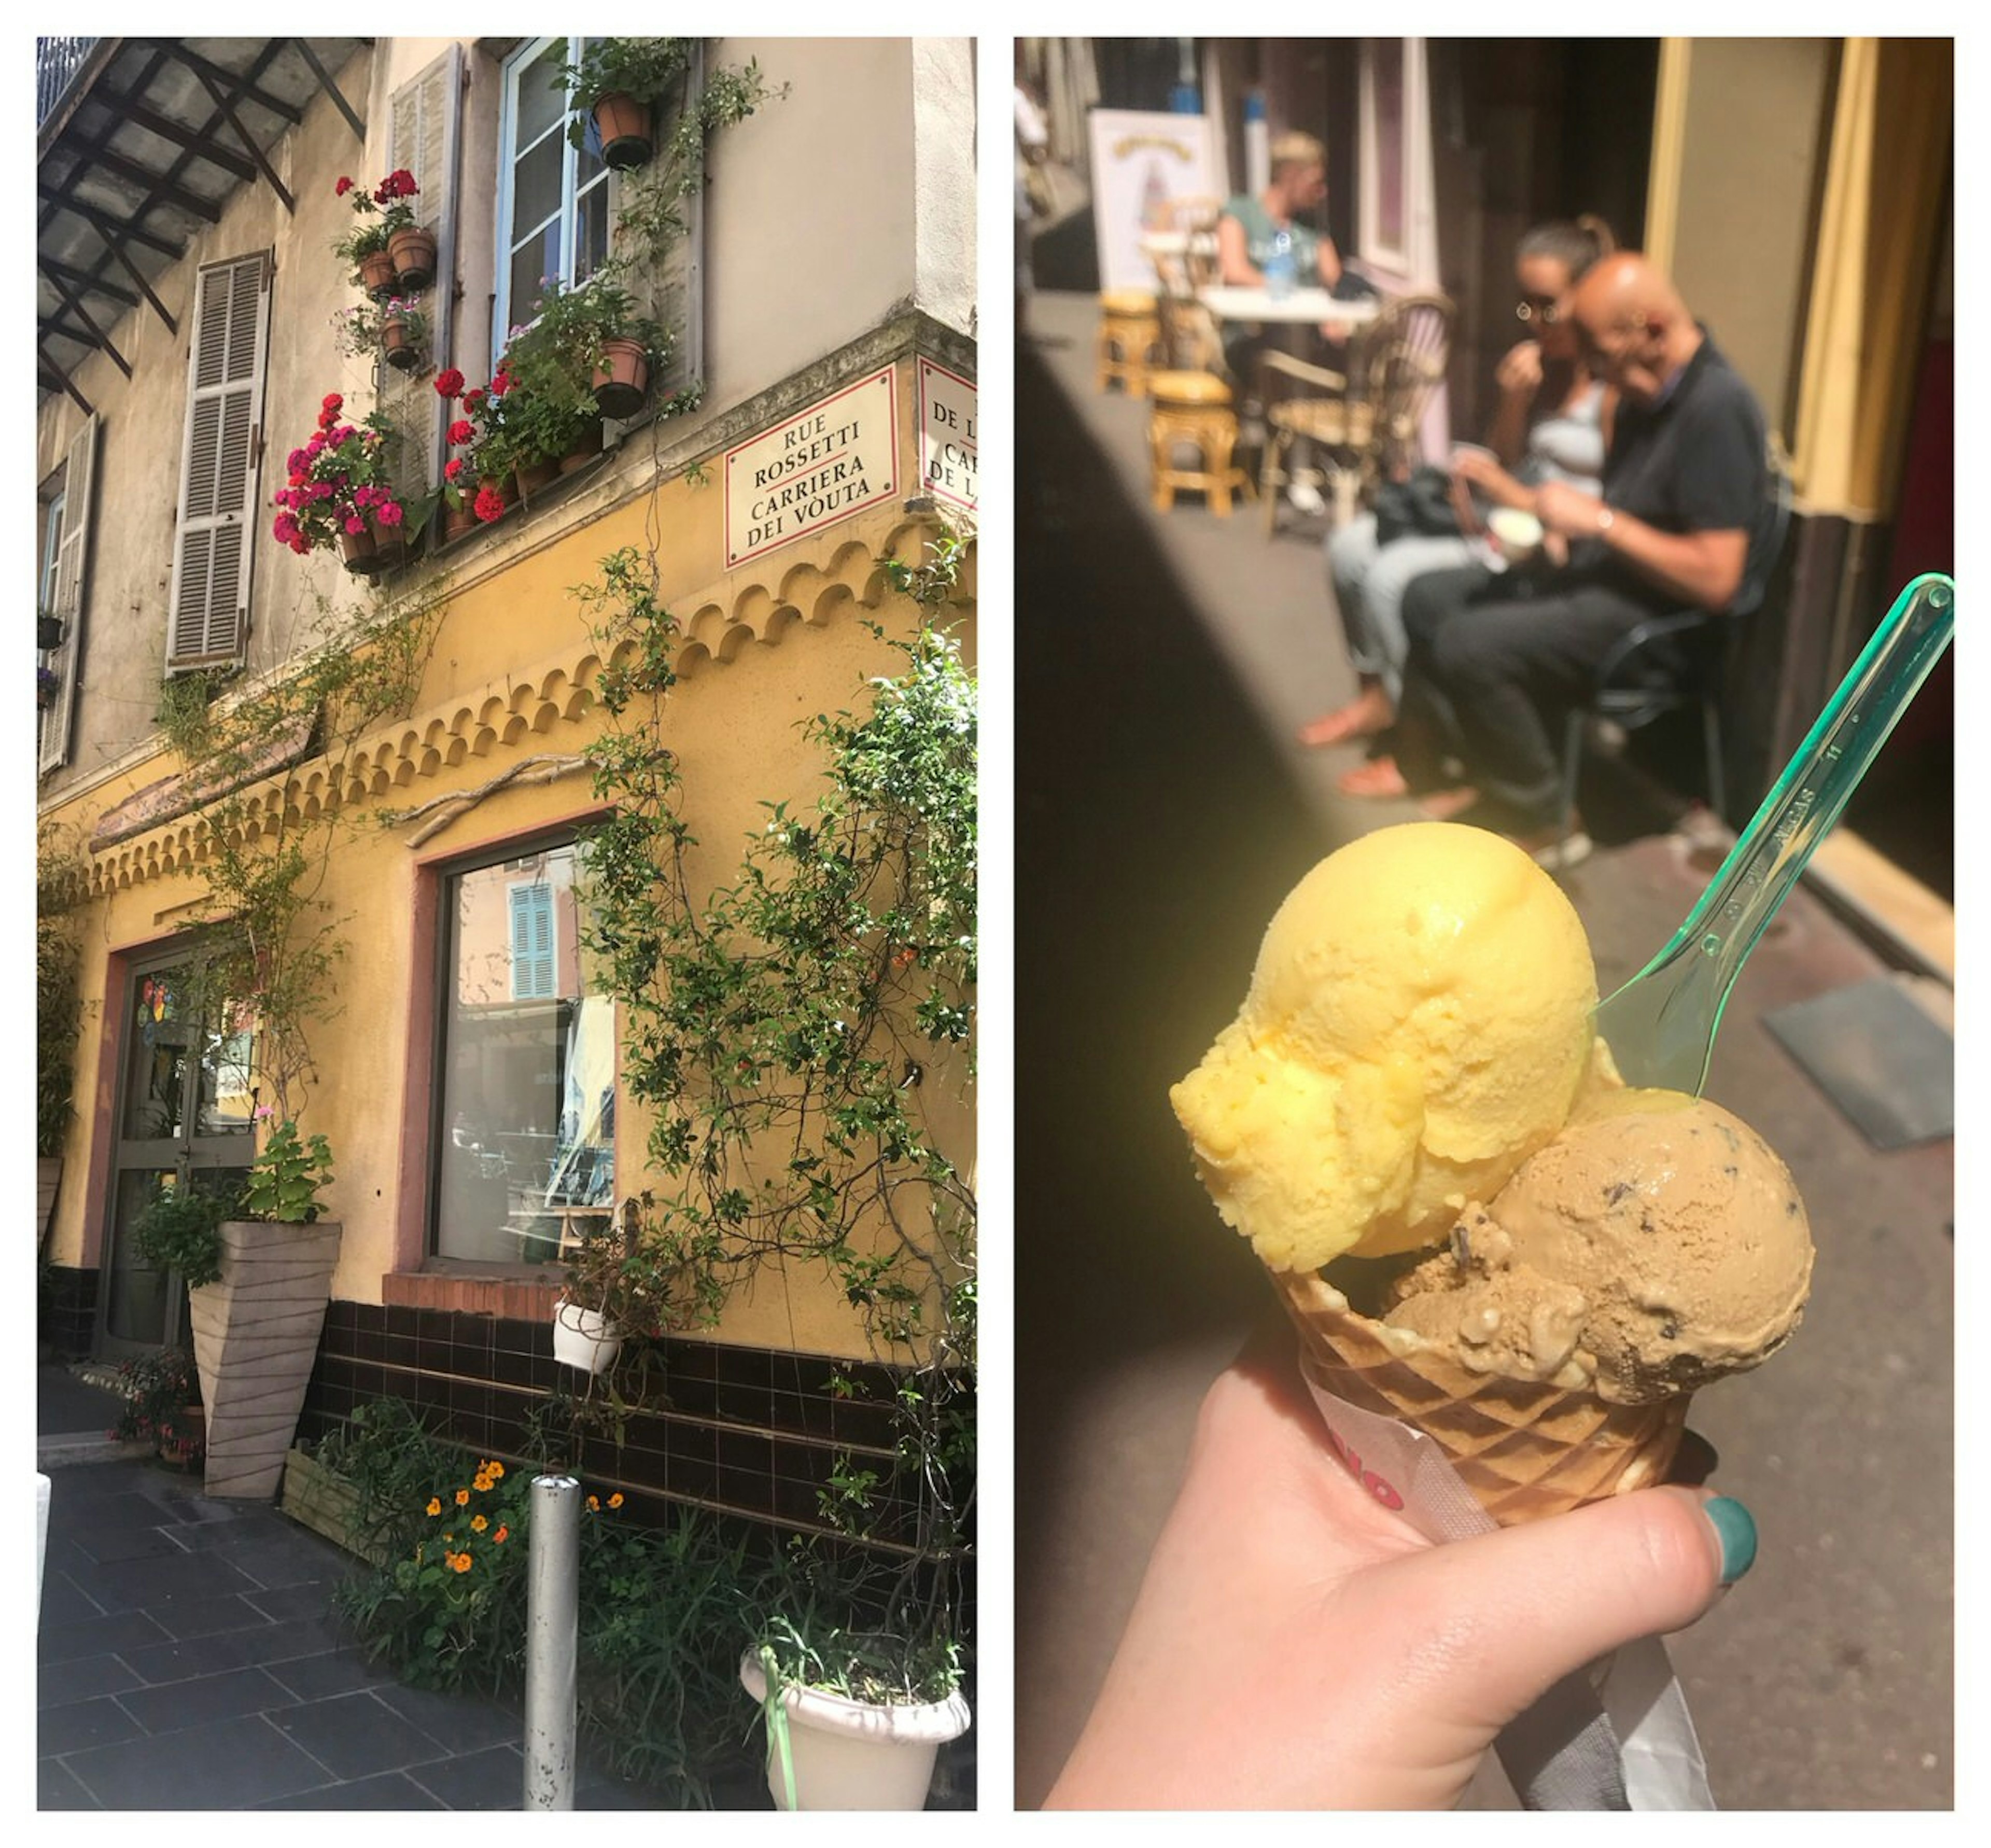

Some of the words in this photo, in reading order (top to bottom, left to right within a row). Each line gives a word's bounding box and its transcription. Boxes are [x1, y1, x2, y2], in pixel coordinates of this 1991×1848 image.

[784, 414, 826, 450] RUE
[933, 400, 958, 429] DE
[754, 421, 860, 489] ROSSETTI
[930, 460, 955, 488] DE
[747, 520, 783, 548] DEI
[794, 478, 871, 525] VÒUTA
[751, 455, 864, 521] CARRIERA
